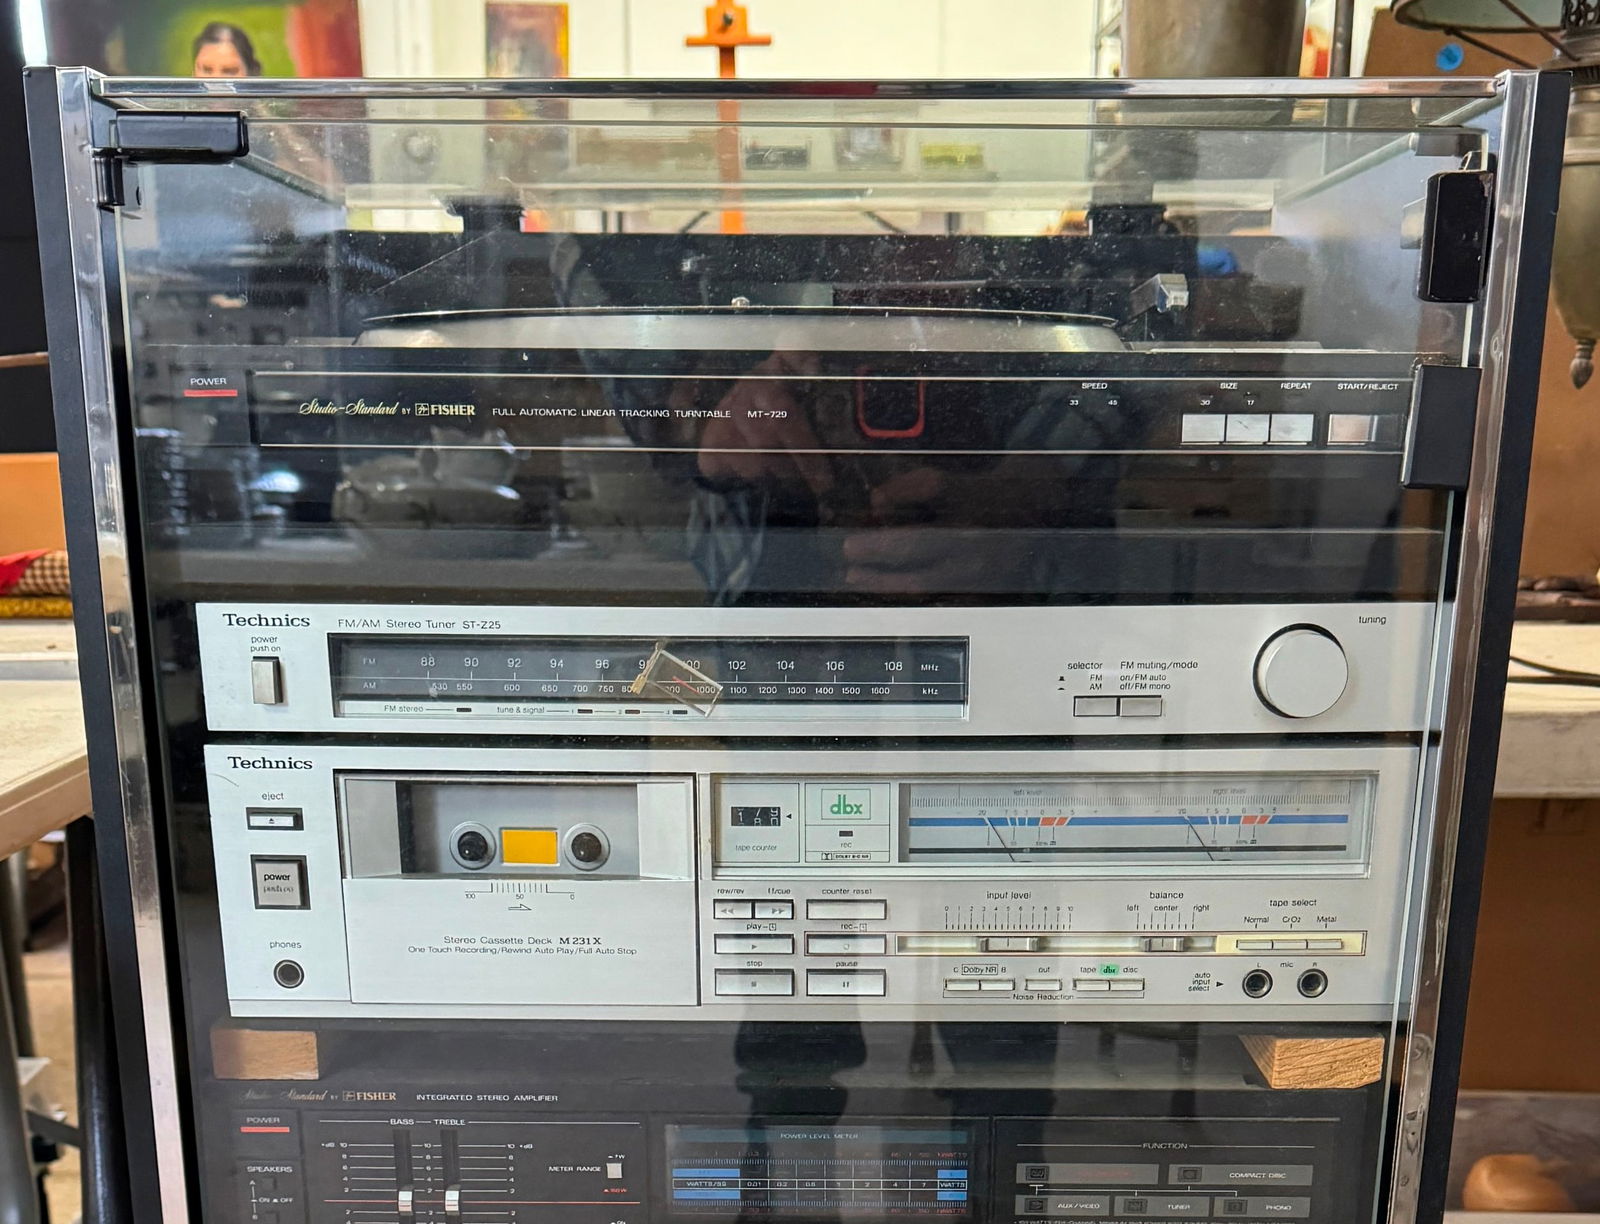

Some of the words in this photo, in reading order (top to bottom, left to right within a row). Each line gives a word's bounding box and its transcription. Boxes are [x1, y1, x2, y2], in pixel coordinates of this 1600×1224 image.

[1082, 382, 1107, 390] SPEED
[1220, 382, 1237, 390] SIZE
[1280, 382, 1311, 390] REPEAT
[1338, 383, 1398, 391] START/REJECT
[431, 405, 475, 415] FISHER
[492, 408, 515, 416] FULL
[520, 408, 576, 416] AUTOMATIC
[581, 409, 615, 417] LINEAR
[619, 410, 669, 418] TRACKING
[674, 410, 731, 418] TURNTABLE
[748, 410, 787, 418] MT-729
[222, 613, 310, 628] Technics
[1359, 615, 1386, 625] tuning
[338, 619, 381, 628] FM/AM
[387, 620, 421, 629] Stereo
[426, 620, 455, 629] Tuner
[462, 620, 501, 630] ST-Z25
[251, 636, 277, 644] power
[251, 645, 269, 653] push
[421, 658, 435, 667] 88
[464, 658, 478, 667] 90
[508, 658, 521, 668] 92
[550, 659, 563, 668] 94
[595, 660, 609, 668] 96
[728, 660, 746, 670] 102
[776, 660, 794, 670] 104
[826, 661, 844, 670] 106
[884, 661, 903, 671] 108
[1068, 661, 1103, 670] selector
[1120, 661, 1134, 669] FM
[1137, 661, 1198, 670] muting/mode
[1120, 674, 1147, 682] on/FM
[730, 687, 747, 695] 1100
[759, 687, 777, 695] 1200
[815, 687, 833, 695] 1400
[842, 687, 860, 695] 1500
[1120, 683, 1147, 691] off/FM
[522, 707, 544, 715] signal
[228, 756, 313, 769] Technics
[262, 792, 284, 801] eject
[830, 794, 862, 815] dbx
[736, 843, 750, 852] tape
[752, 843, 777, 851] counter
[264, 874, 290, 882] power
[987, 891, 1008, 900] input
[1011, 891, 1031, 899] level
[1150, 891, 1183, 899] balance
[1270, 899, 1288, 907] tape
[1292, 899, 1317, 907] select
[444, 936, 476, 944] Stereo
[480, 936, 523, 945] Cassette
[528, 937, 552, 945] Deck
[270, 941, 301, 949] phones
[964, 966, 984, 974] Dolby
[1081, 967, 1096, 975] tape
[357, 1092, 396, 1101] FISHER
